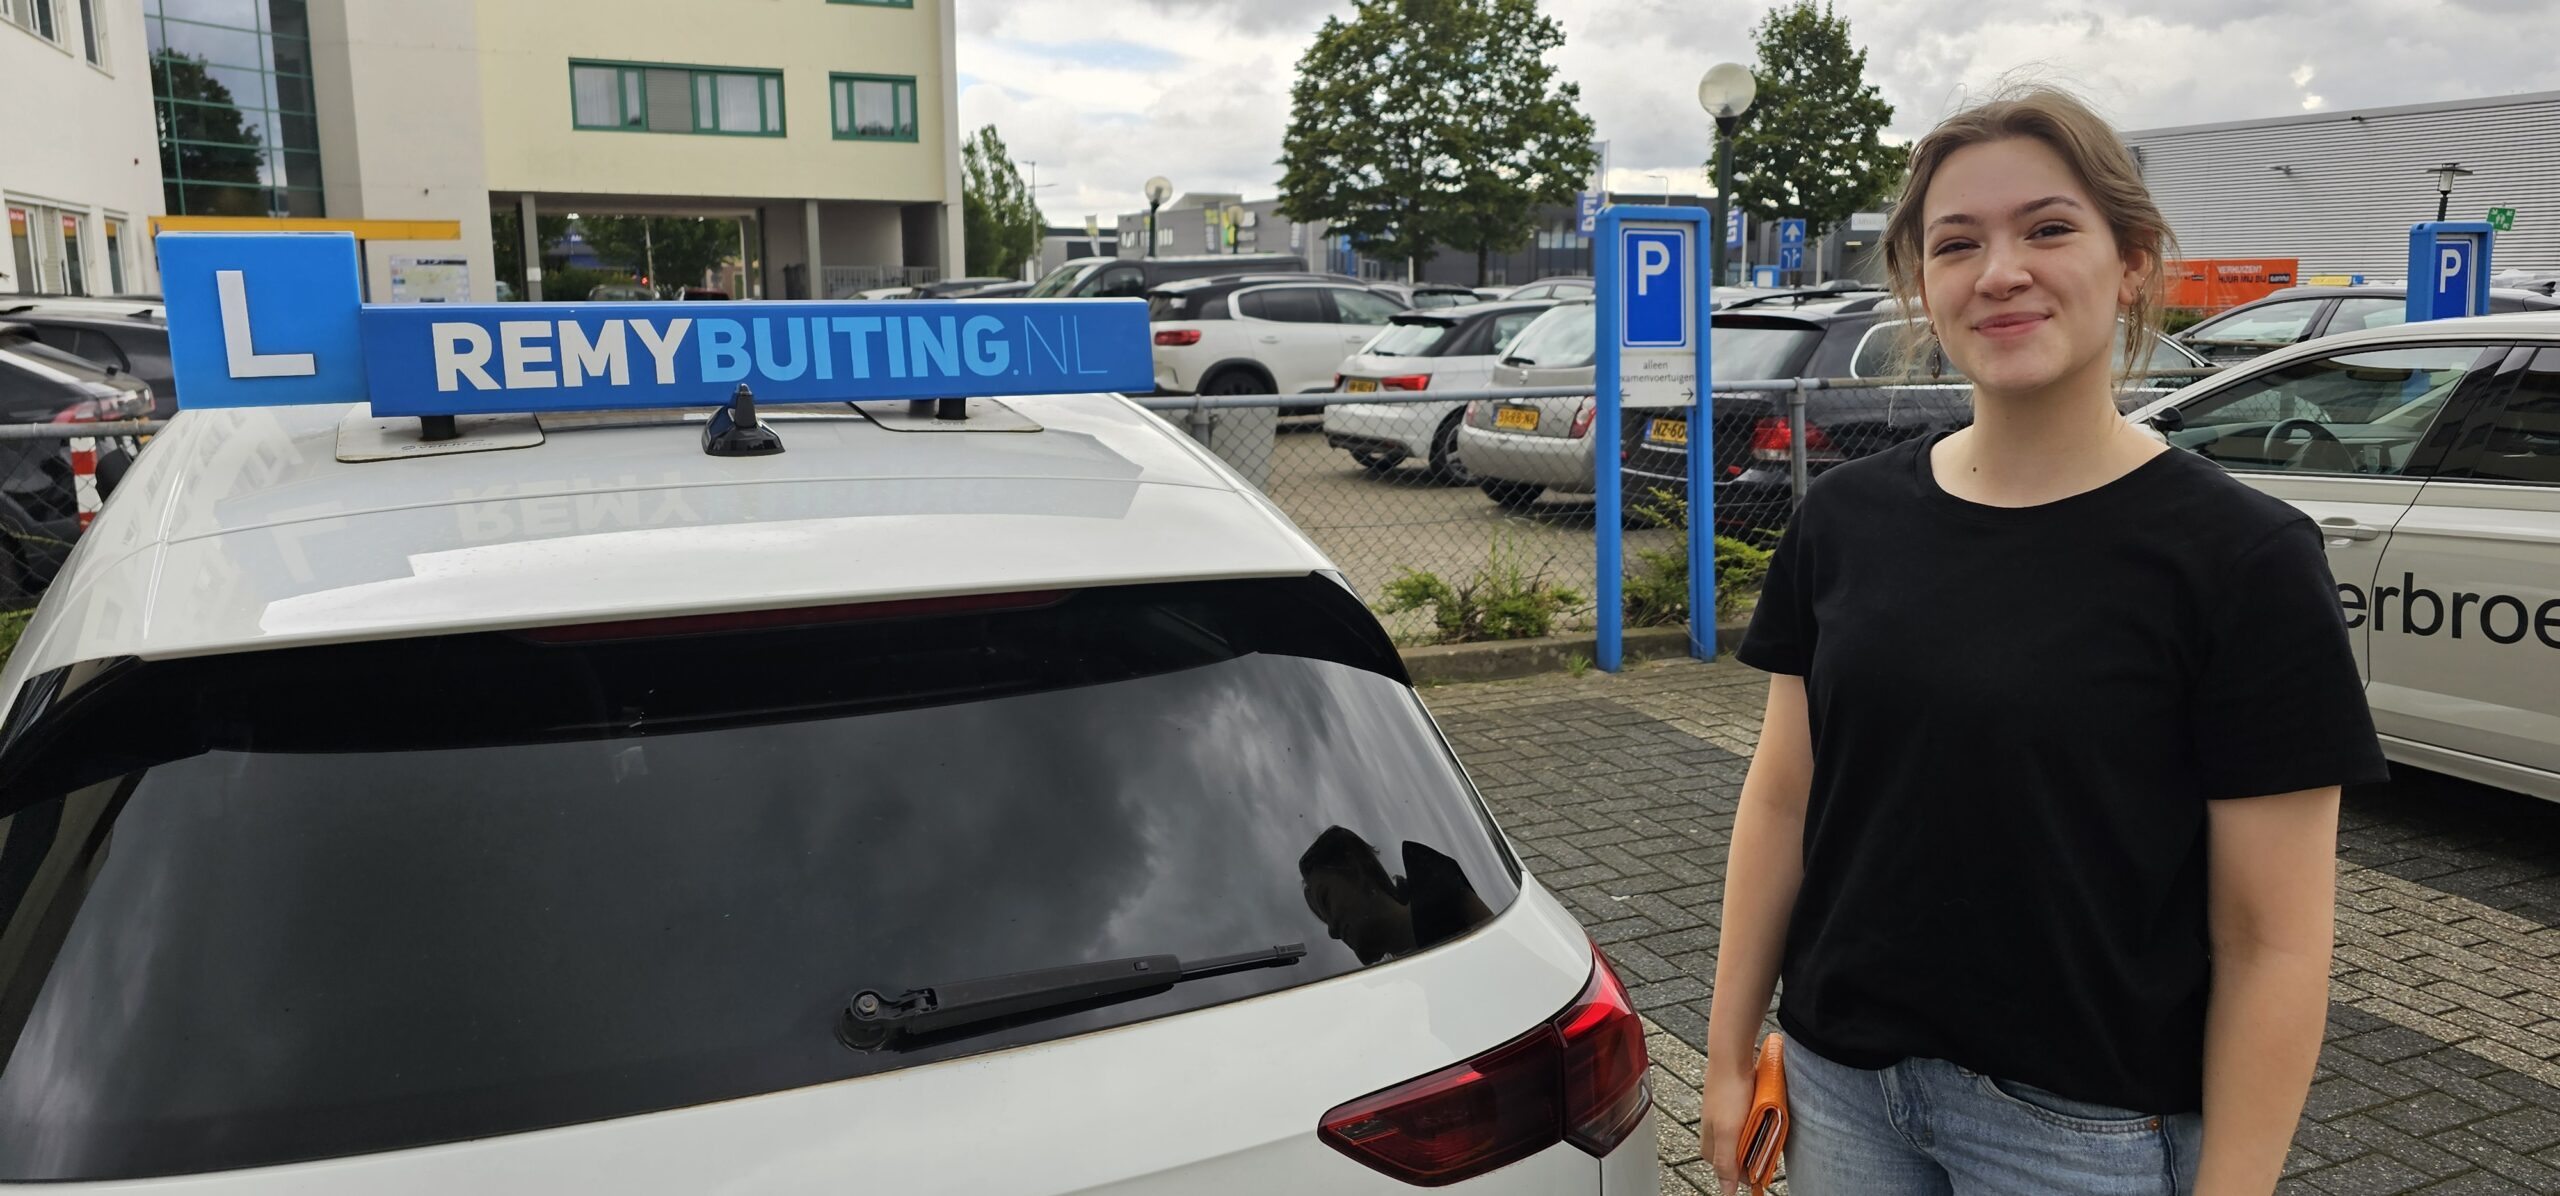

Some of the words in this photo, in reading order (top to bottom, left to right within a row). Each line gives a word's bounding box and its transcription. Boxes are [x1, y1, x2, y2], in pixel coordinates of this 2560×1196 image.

[1638, 241, 1671, 296] P
[2439, 249, 2461, 294] P
[216, 270, 316, 378] L
[431, 314, 1108, 392] REMYBUITING.NL
[1643, 359, 1668, 370] alleen
[1621, 373, 1695, 385] xamenvoertuigen
[1652, 421, 1687, 439] NZ-60
